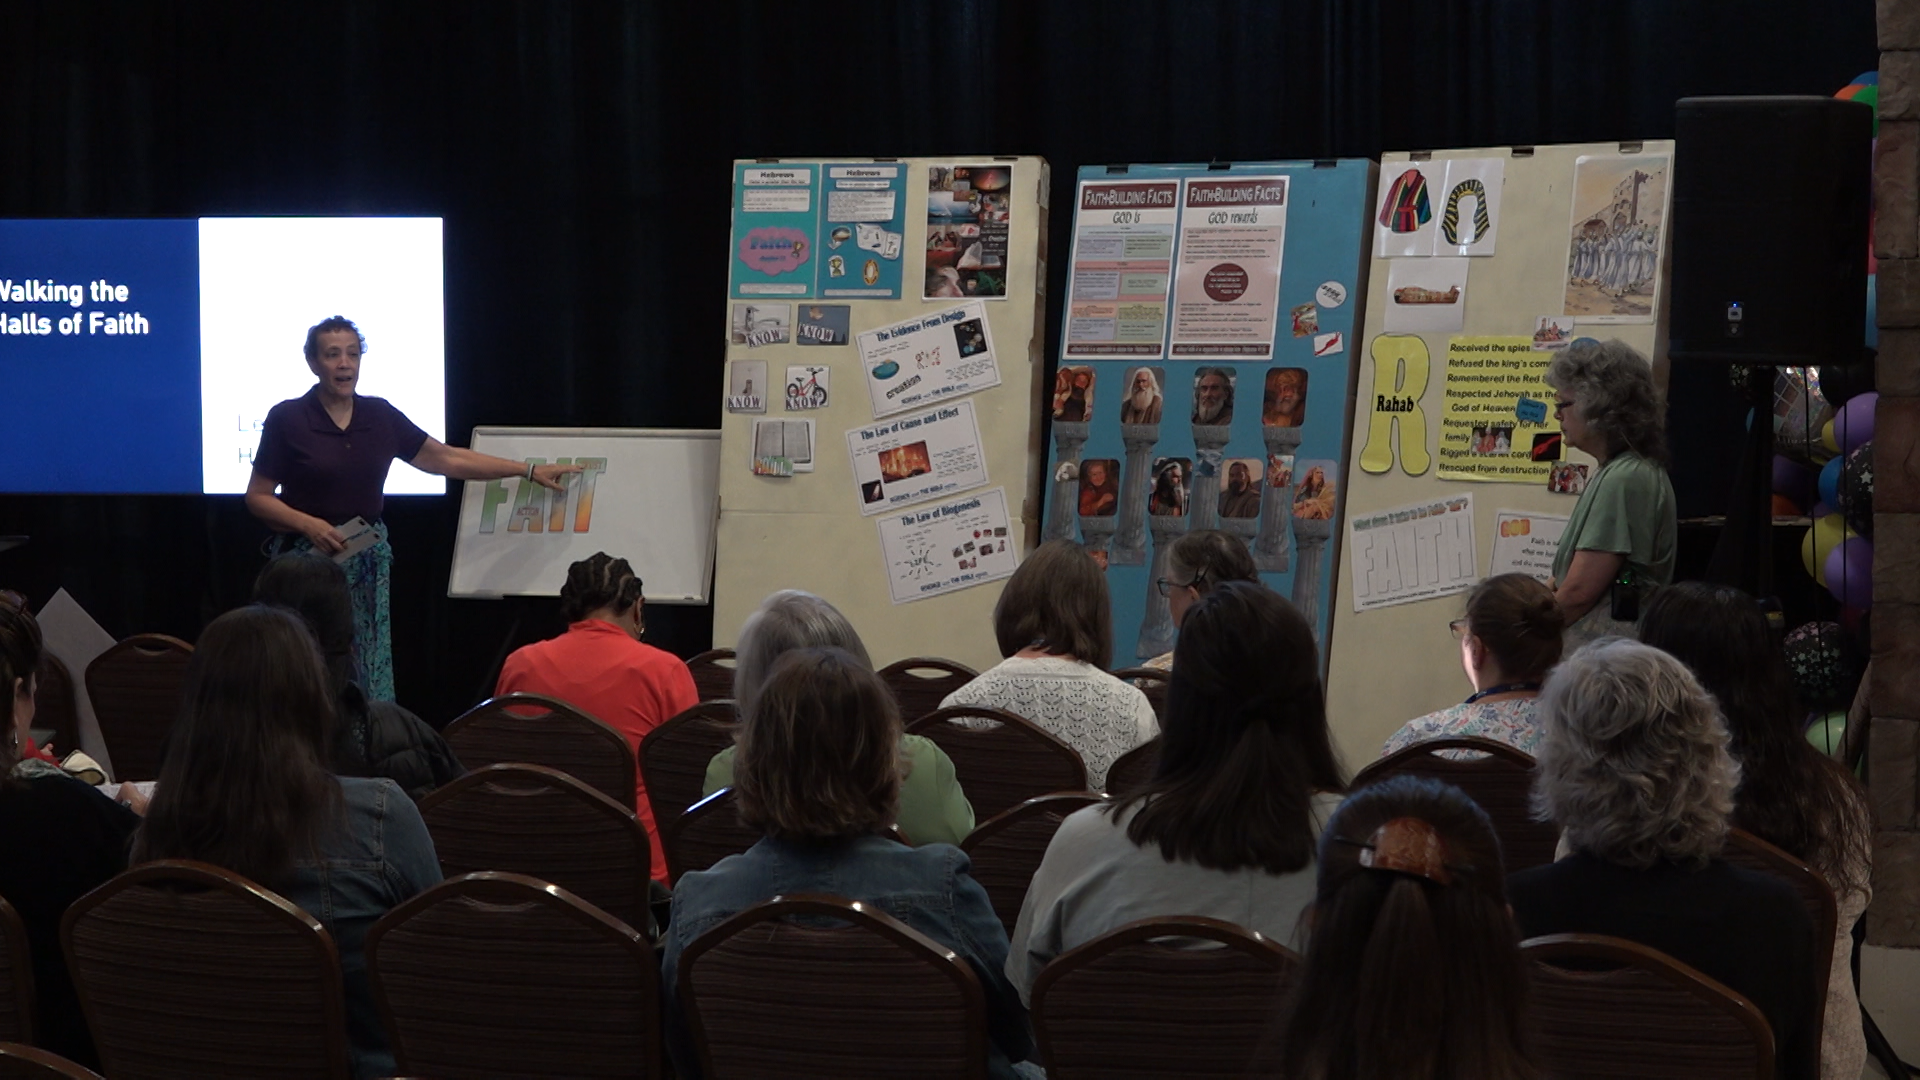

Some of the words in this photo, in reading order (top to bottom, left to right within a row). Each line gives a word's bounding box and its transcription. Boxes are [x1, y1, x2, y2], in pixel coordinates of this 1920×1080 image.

[1146, 188, 1173, 204] FACTS
[1254, 185, 1281, 201] FACTS
[1112, 211, 1132, 224] GOD
[1208, 211, 1228, 225] GOD
[0, 279, 83, 308] Walking
[90, 279, 129, 302] the
[59, 312, 83, 336] of
[89, 312, 149, 336] Faith
[876, 333, 891, 342] The
[891, 323, 921, 338] Evidence
[941, 310, 966, 324] Design
[747, 329, 783, 348] KNOW
[798, 324, 834, 342] KNOW
[1450, 344, 1490, 352] Received
[1491, 344, 1506, 352] the
[1507, 344, 1531, 354] spies
[1448, 358, 1484, 368] Refused
[1486, 359, 1500, 368] the
[1502, 359, 1527, 370] king's
[1447, 373, 1505, 383] Remembered
[1507, 374, 1521, 383] the
[1523, 374, 1540, 383] Red
[1446, 389, 1492, 400] Respected
[1493, 389, 1530, 398] Jehovah
[727, 396, 763, 409] KNOW
[786, 397, 820, 409] KNOW
[1376, 395, 1414, 412] Rahab
[1452, 403, 1469, 412] God
[1471, 403, 1481, 412] of
[1482, 404, 1516, 412] Heaven
[860, 430, 875, 440] The
[876, 427, 890, 437] Law
[891, 424, 899, 433] of
[900, 418, 922, 430] Cause
[924, 413, 937, 424] and
[938, 407, 959, 420] Effect
[1443, 418, 1488, 428] Requested
[1445, 433, 1470, 443] family
[1440, 448, 1470, 459] Rigged
[1439, 464, 1476, 473] Rescued
[1478, 464, 1498, 474] from
[1499, 465, 1549, 474] destruction
[479, 457, 607, 533] FAIT
[901, 515, 916, 526] The
[916, 512, 930, 523] Law
[932, 508, 940, 518] of
[941, 498, 981, 517] Biogenesis
[1356, 514, 1474, 599] FAITH
